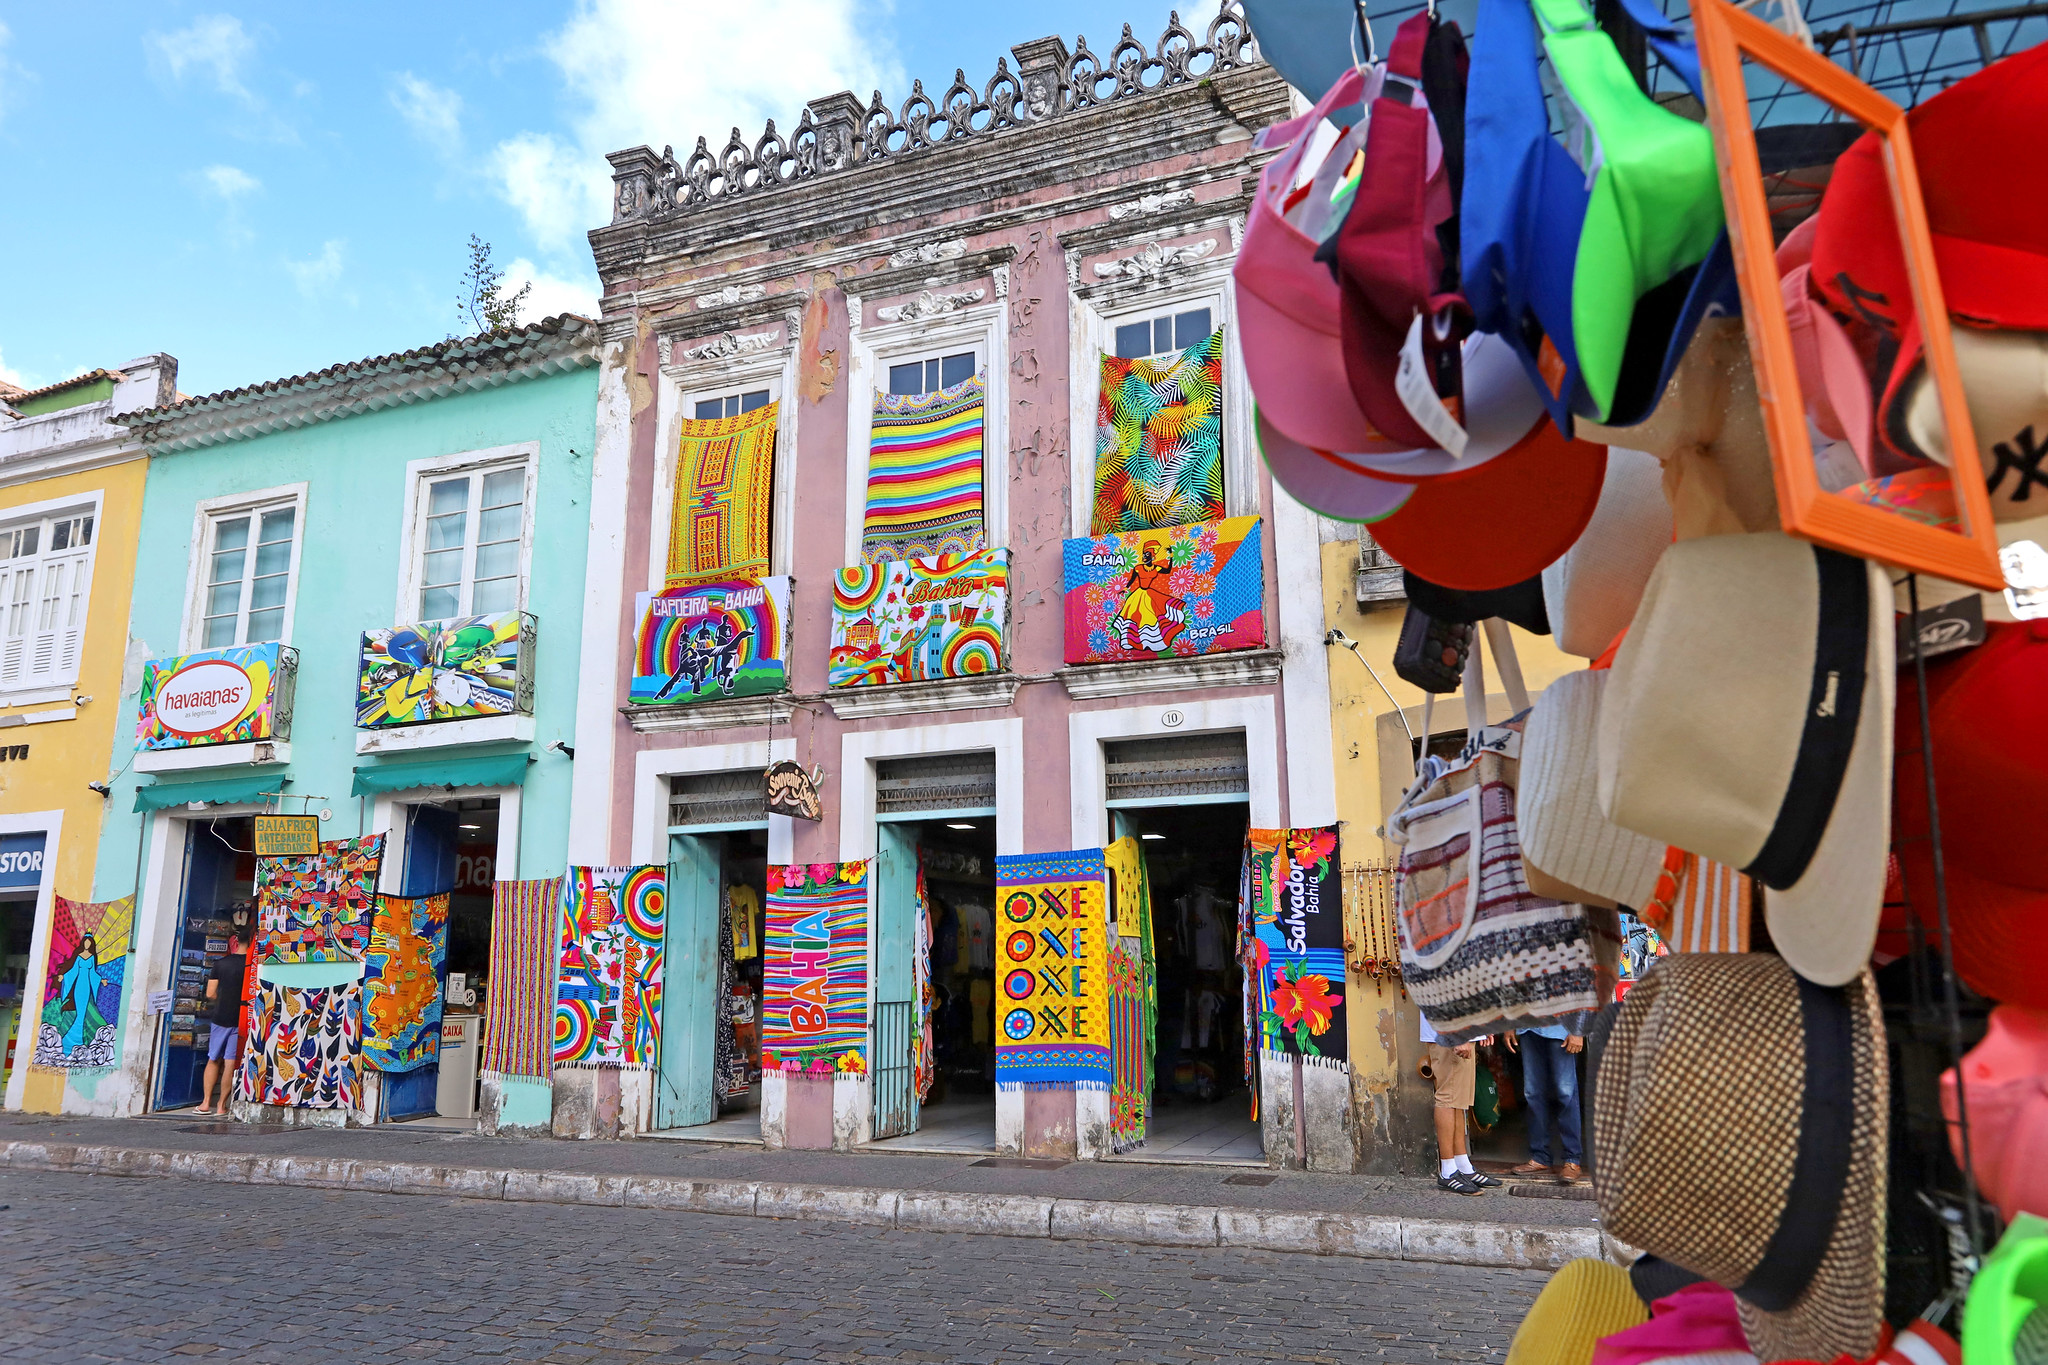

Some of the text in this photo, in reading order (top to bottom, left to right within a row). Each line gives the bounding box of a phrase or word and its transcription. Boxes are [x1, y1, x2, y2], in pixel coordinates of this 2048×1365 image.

[1082, 554, 1125, 567] BAHIA
[651, 596, 709, 618] CAPOEIRA
[724, 585, 765, 612] BAHIA
[906, 576, 974, 605] Bahia
[1189, 623, 1235, 640] BRASIL
[165, 687, 240, 711] havaianas
[1167, 713, 1178, 723] 10
[768, 769, 802, 796] Souvenir
[791, 774, 819, 817] Bahia
[256, 819, 317, 831] BAIAFRICA
[322, 810, 328, 818] 8
[1284, 858, 1307, 955] Salvador
[1305, 875, 1320, 914] Bahia
[789, 909, 831, 1034] BAHIA
[622, 936, 642, 1035] Salvador
[443, 1024, 463, 1037] CAIXA
[398, 1038, 436, 1066] BAHIA
